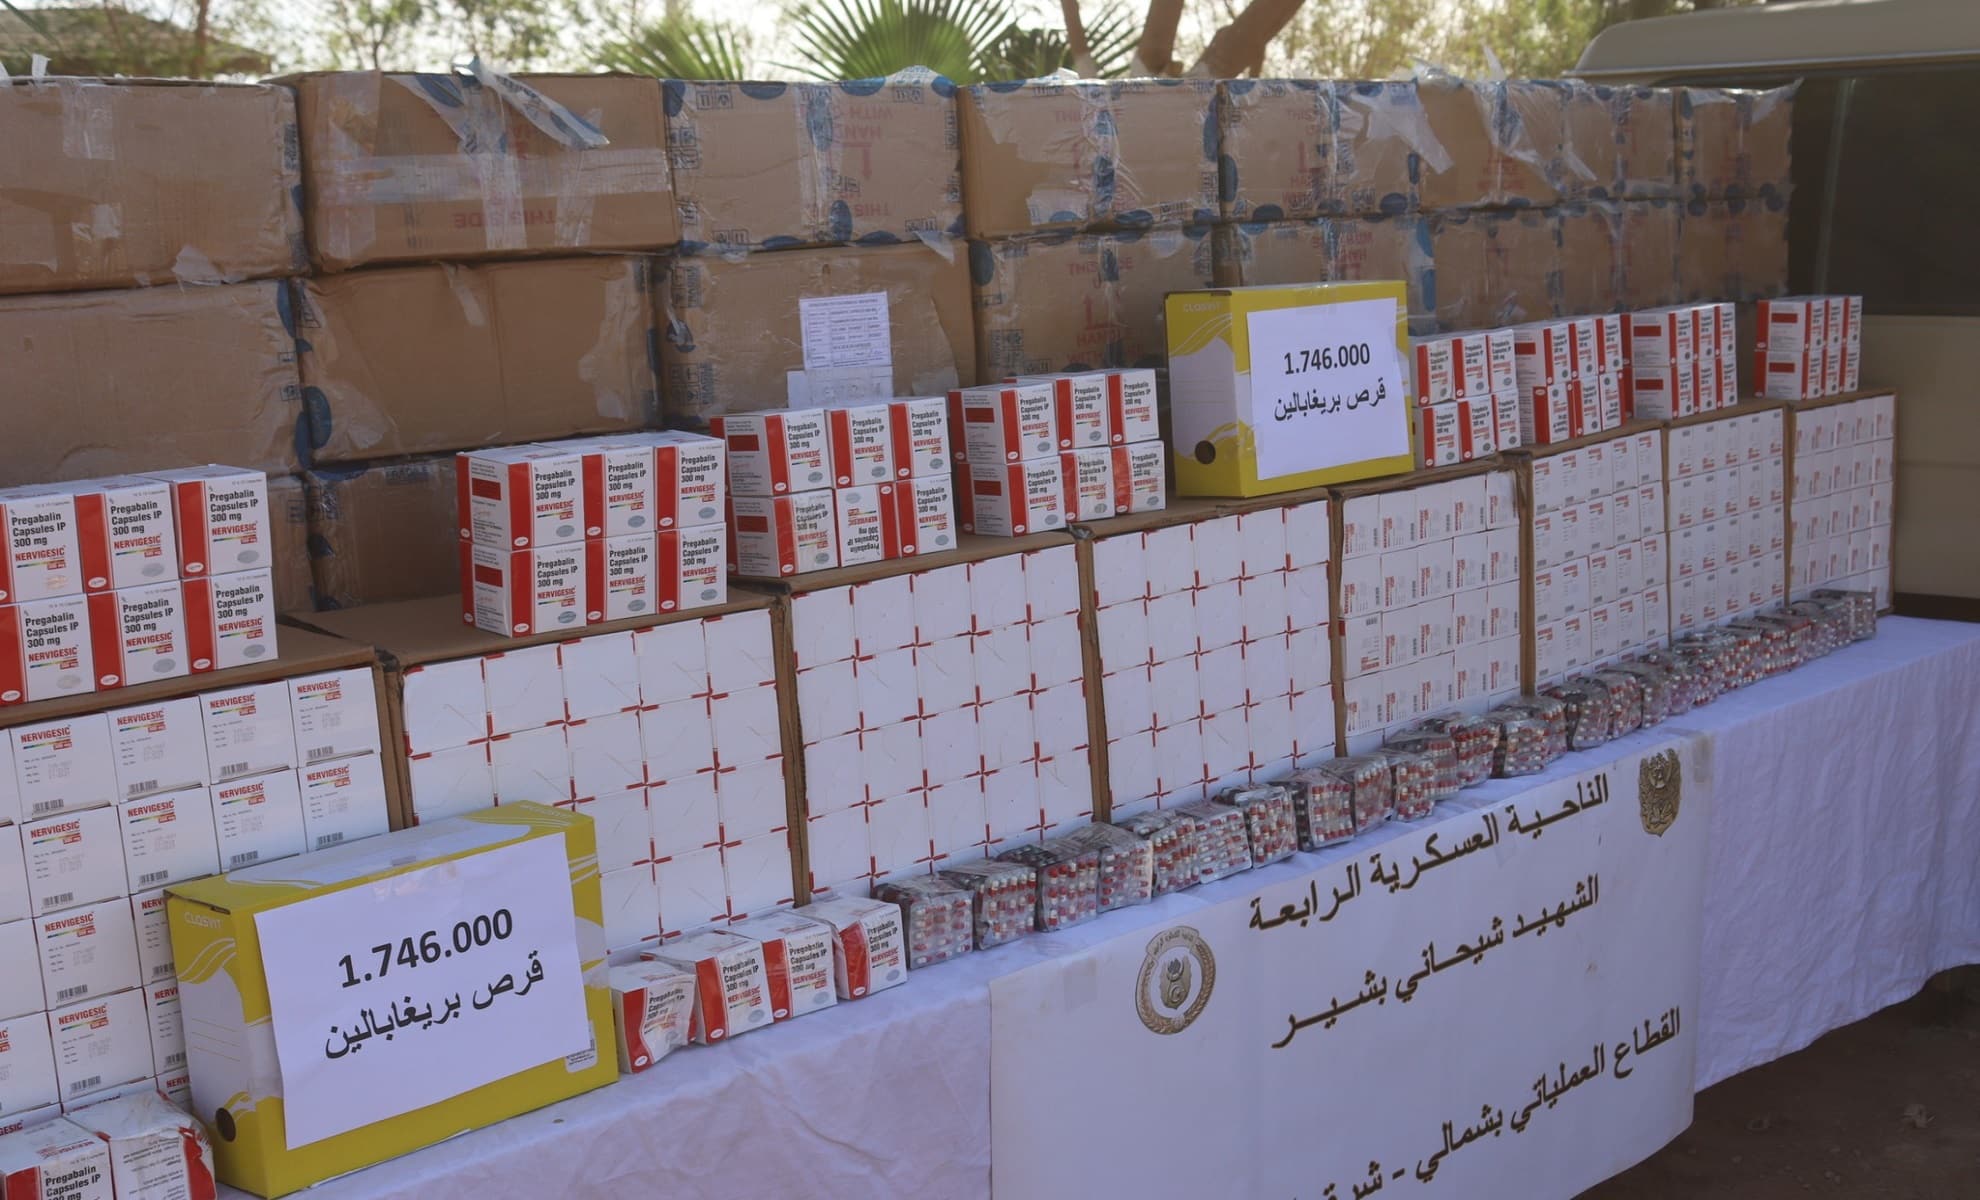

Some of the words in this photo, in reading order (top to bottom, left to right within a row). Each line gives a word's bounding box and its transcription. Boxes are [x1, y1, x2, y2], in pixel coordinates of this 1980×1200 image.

[1284, 343, 1370, 375] 1.746.000
[1347, 377, 1386, 410] قرص
[1274, 389, 1340, 421] بريغابالين
[608, 461, 643, 473] Pregabalin
[682, 454, 715, 465] Pregabalin
[536, 469, 572, 482] Pregabalin
[609, 472, 638, 482] Capsules
[640, 469, 646, 478] IP
[682, 464, 710, 474] Capsules
[712, 462, 718, 470] IP
[536, 480, 567, 491] Capsules
[568, 477, 576, 486] IP
[681, 474, 693, 483] 300
[609, 482, 621, 491] 300
[681, 484, 716, 494] NERVIGESIC
[210, 489, 254, 502] Pregabalin
[536, 491, 549, 500] 300
[609, 491, 644, 503] NERVIGESIC
[111, 501, 158, 515] Pregabalin
[211, 501, 248, 513] Capsules
[250, 498, 258, 508] IP
[536, 500, 574, 512] NERVIGESIC
[11, 512, 61, 526] Pregabalin
[112, 513, 151, 525] Capsules
[153, 510, 162, 520] IP
[211, 513, 227, 523] 300
[229, 513, 242, 521] mg
[13, 525, 55, 537] Capsules
[57, 522, 66, 532] IP
[113, 526, 129, 536] 300
[131, 525, 145, 533] mg
[212, 523, 257, 536] NERVIGESIC
[14, 537, 31, 548] 300
[33, 537, 47, 546] mg
[114, 535, 161, 550] NERVIGESIC
[683, 537, 717, 548] Pregabalin
[15, 547, 64, 562] NERVIGESIC
[610, 546, 645, 558] Pregabalin
[683, 547, 712, 557] Capsules
[713, 545, 720, 553] IP
[537, 557, 575, 569] Pregabalin
[610, 556, 640, 567] Capsules
[641, 554, 648, 562] IP
[683, 557, 694, 566] 300
[538, 568, 569, 578] Capsules
[571, 565, 578, 574] IP
[610, 567, 622, 576] 300
[683, 566, 717, 577] NERVIGESIC
[538, 579, 550, 588] 300
[610, 576, 646, 587] NERVIGESIC
[216, 584, 260, 599] Pregabalin
[538, 587, 576, 599] NERVIGESIC
[123, 598, 169, 613] Pregabalin
[217, 596, 254, 609] Capsules
[256, 593, 264, 603] IP
[25, 612, 74, 627] Pregabalin
[124, 611, 163, 623] Capsules
[165, 607, 174, 617] IP
[218, 609, 233, 619] 300
[235, 608, 247, 616] mg
[26, 625, 68, 637] Capsules
[70, 621, 79, 631] IP
[125, 623, 141, 634] 300
[143, 622, 156, 631] mg
[218, 618, 262, 632] NERVIGESIC
[27, 638, 44, 648] 300
[47, 637, 60, 645] mg
[126, 632, 172, 647] NERVIGESIC
[28, 647, 77, 662] NERVIGESIC
[297, 679, 340, 694] NERVIGESIC
[210, 694, 256, 709] NERVIGESIC
[117, 710, 164, 726] NERVIGESIC
[21, 726, 71, 743] NERVIGESIC
[306, 766, 349, 782] NERVIGESIC
[219, 783, 264, 799] NERVIGESIC
[128, 800, 174, 817] NERVIGESIC
[1508, 774, 1609, 838] الناحية
[30, 821, 80, 838] NERVIGESIC
[1370, 813, 1500, 894] العسكرية
[1250, 864, 1360, 932] الرابعة
[1512, 874, 1599, 937] الشهيد
[44, 913, 94, 933] NERVIGESIC
[338, 909, 513, 988] 1.746.000
[1396, 917, 1504, 1004] شيحاني
[473, 950, 544, 1010] قرص
[58, 1005, 106, 1025] NERVIGESIC
[1272, 970, 1388, 1050] بشير
[325, 992, 461, 1058] بريغابالين
[1614, 1006, 1680, 1081] القطاع
[1511, 1044, 1605, 1134] العملياتي
[1415, 1104, 1502, 1184] بشمالي
[45, 1165, 96, 1186] Pregabalin
[46, 1179, 89, 1197] Capsules
[92, 1174, 101, 1183] IP
